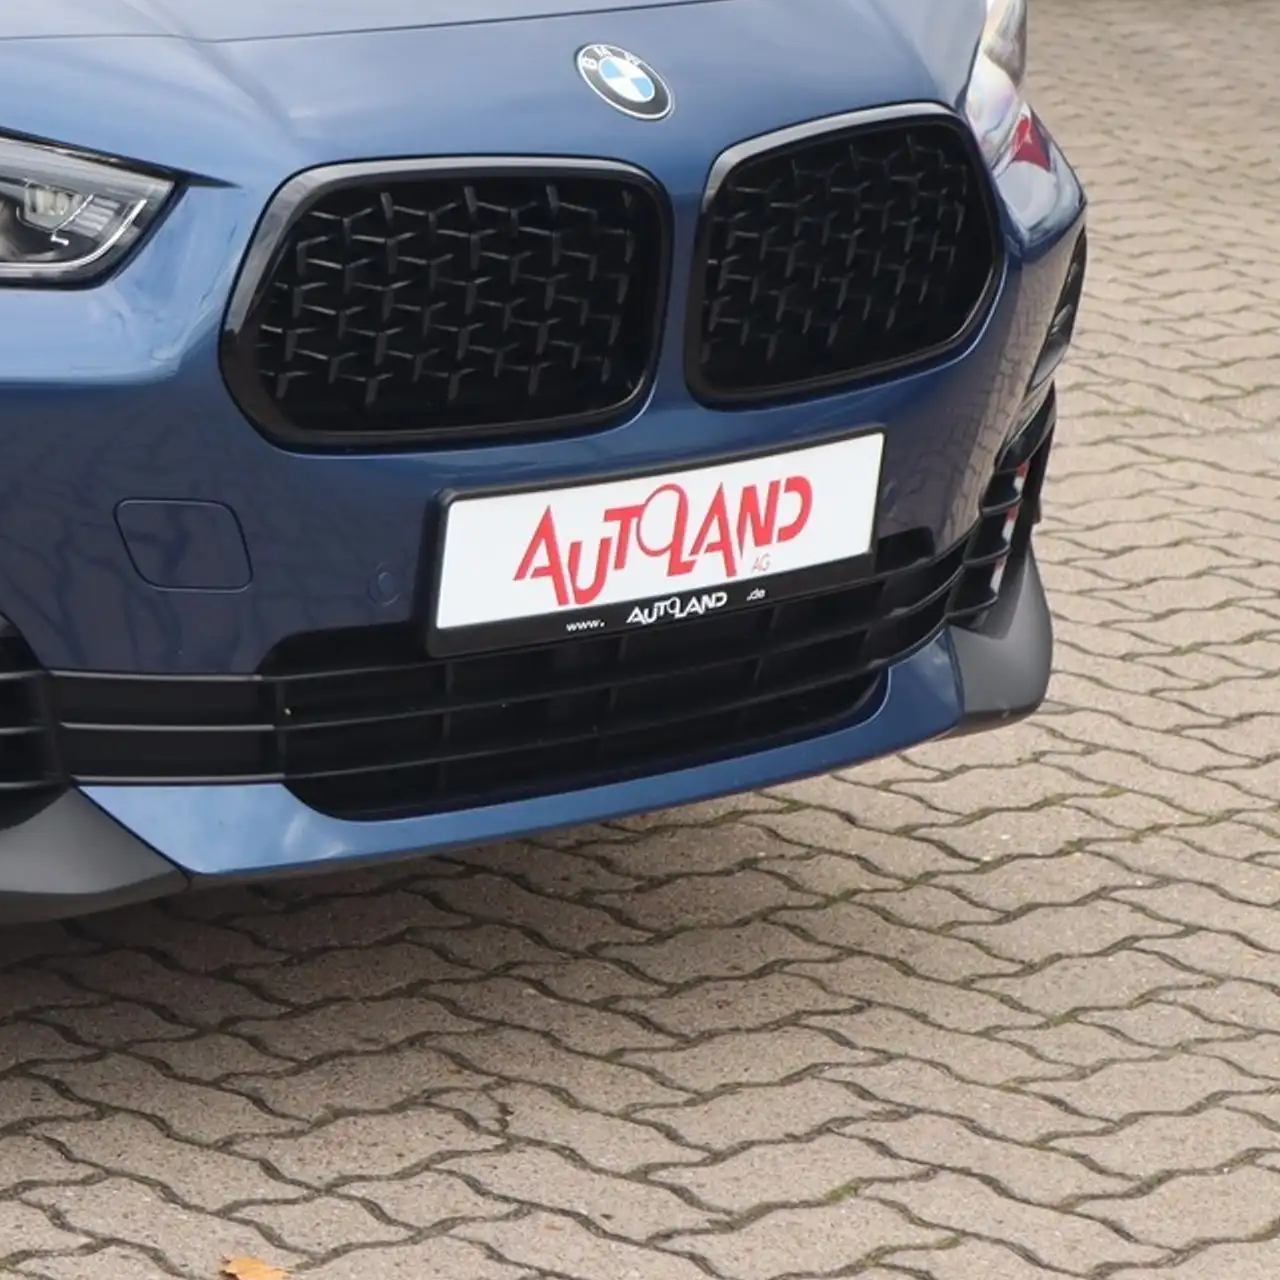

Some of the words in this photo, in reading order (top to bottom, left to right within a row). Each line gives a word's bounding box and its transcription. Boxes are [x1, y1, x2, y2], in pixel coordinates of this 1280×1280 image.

[513, 475, 814, 607] AUTOLAND
[565, 617, 606, 633] www.
[626, 590, 729, 626] AUTOLAND
[746, 586, 766, 602] .de
